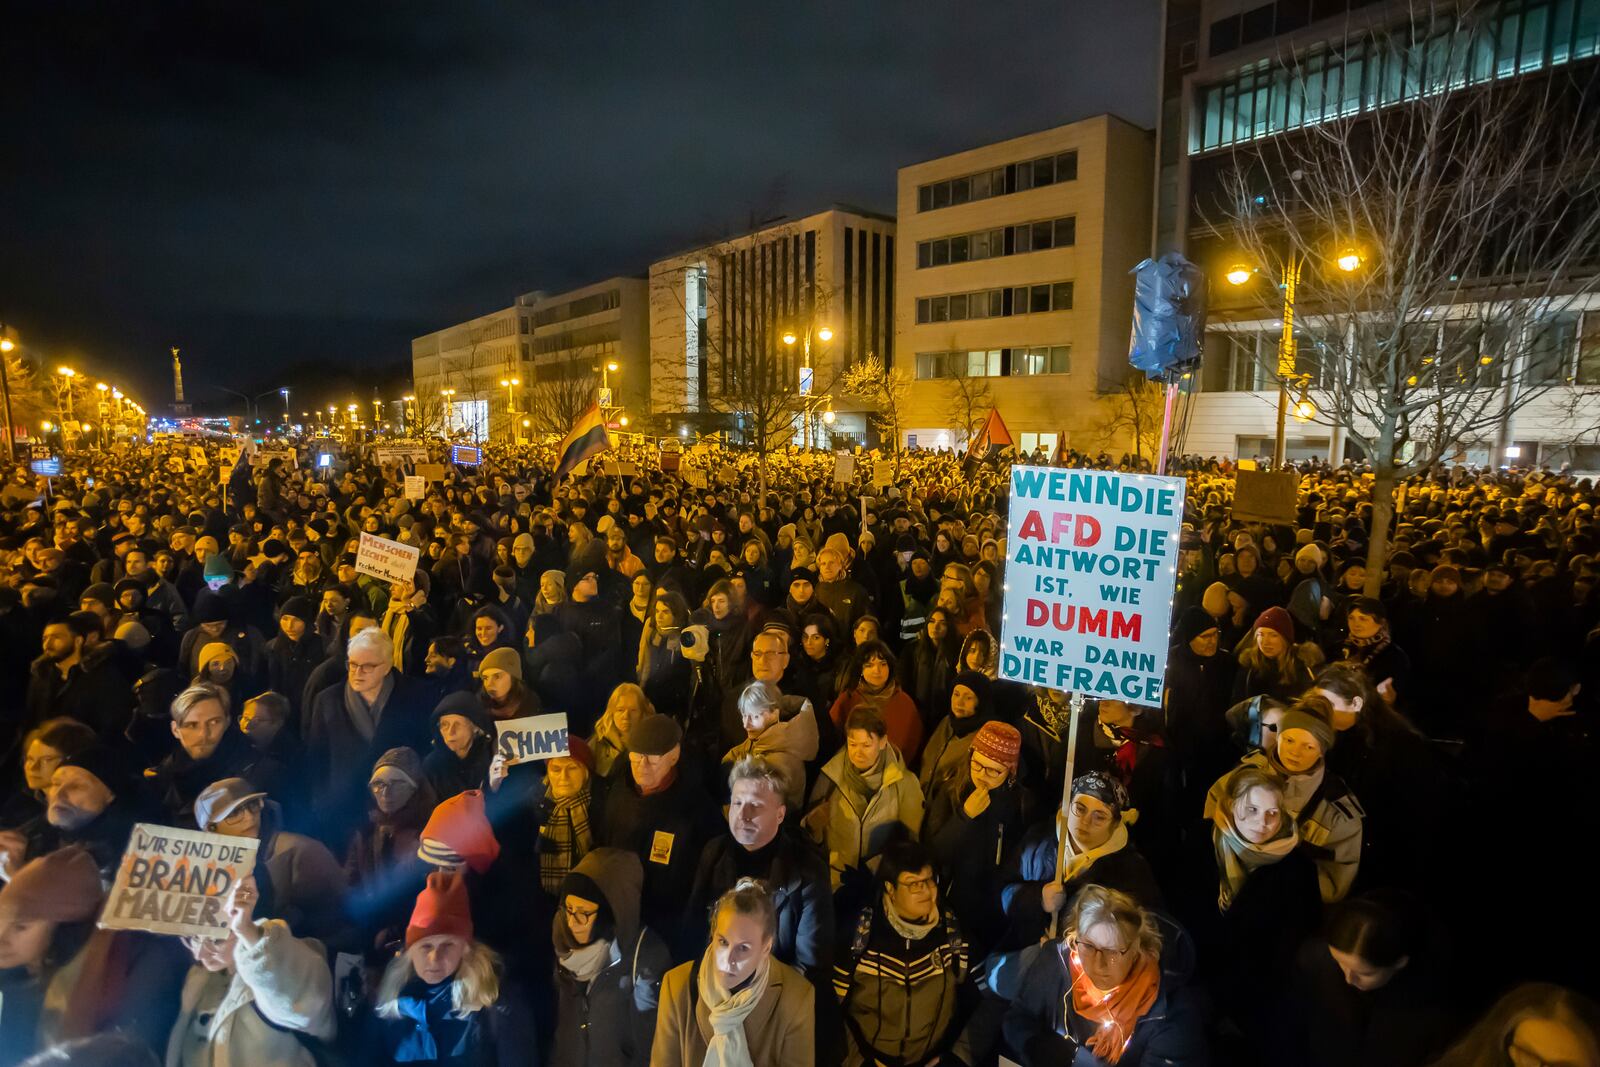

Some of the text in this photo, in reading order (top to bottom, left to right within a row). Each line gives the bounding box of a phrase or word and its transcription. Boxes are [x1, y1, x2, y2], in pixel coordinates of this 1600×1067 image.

[1013, 470, 1176, 516] WENN DIE
[1018, 509, 1168, 556] AFD DIE
[1014, 544, 1160, 582] ANTWORT
[1100, 584, 1141, 605] WIE
[1026, 598, 1142, 643] DUMM
[1014, 636, 1155, 673] WAR DANN
[1002, 653, 1161, 703] DIE FRAGE
[499, 728, 568, 760] SHAME
[137, 834, 248, 864] WIR SIND DIE
[127, 857, 231, 897] BRAND
[113, 889, 228, 928] MAUER.
